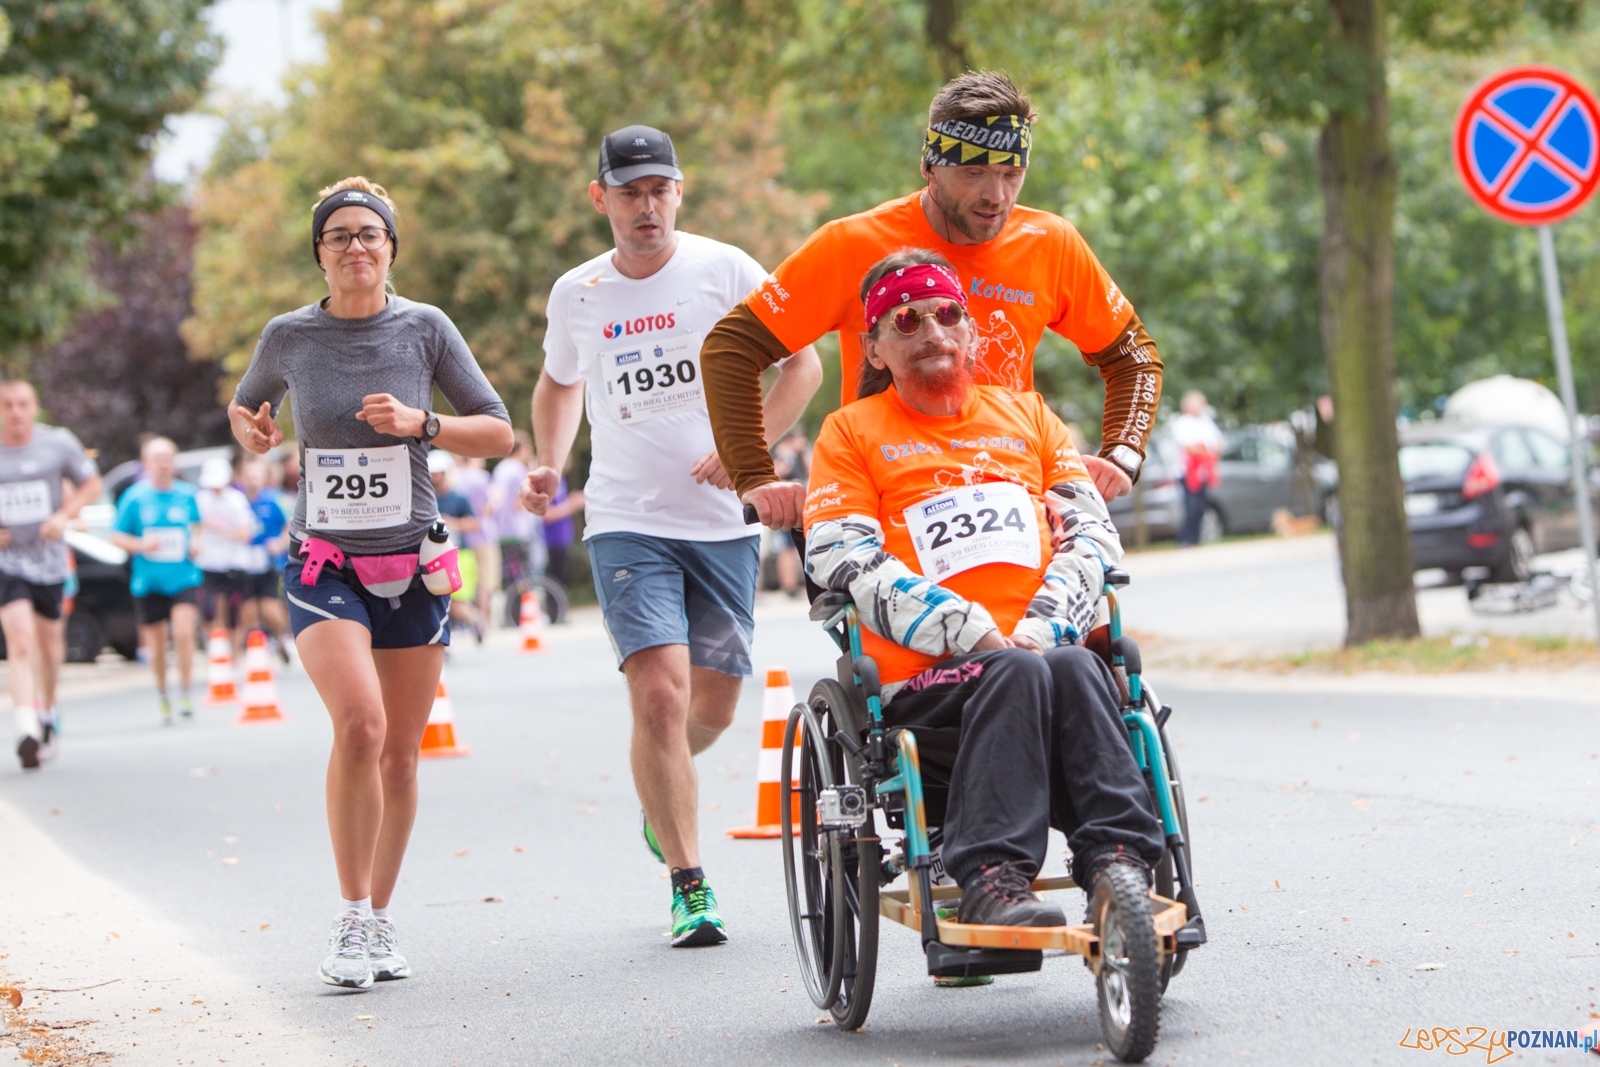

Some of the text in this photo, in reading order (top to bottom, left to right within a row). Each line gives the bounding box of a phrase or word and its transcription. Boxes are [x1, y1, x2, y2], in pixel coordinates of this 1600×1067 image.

[969, 276, 1036, 306] Kotana
[625, 312, 676, 336] LOTOS
[617, 359, 696, 396] 1930
[1142, 373, 1156, 403] 966
[632, 401, 643, 409] 39
[643, 397, 662, 407] BIEG
[1128, 410, 1150, 447] 2016
[325, 472, 389, 500] 295
[330, 503, 402, 515] 39 BIEG LECHITÓW
[926, 507, 1026, 550] 2324
[950, 550, 962, 559] 39
[963, 542, 987, 554] BIEG
